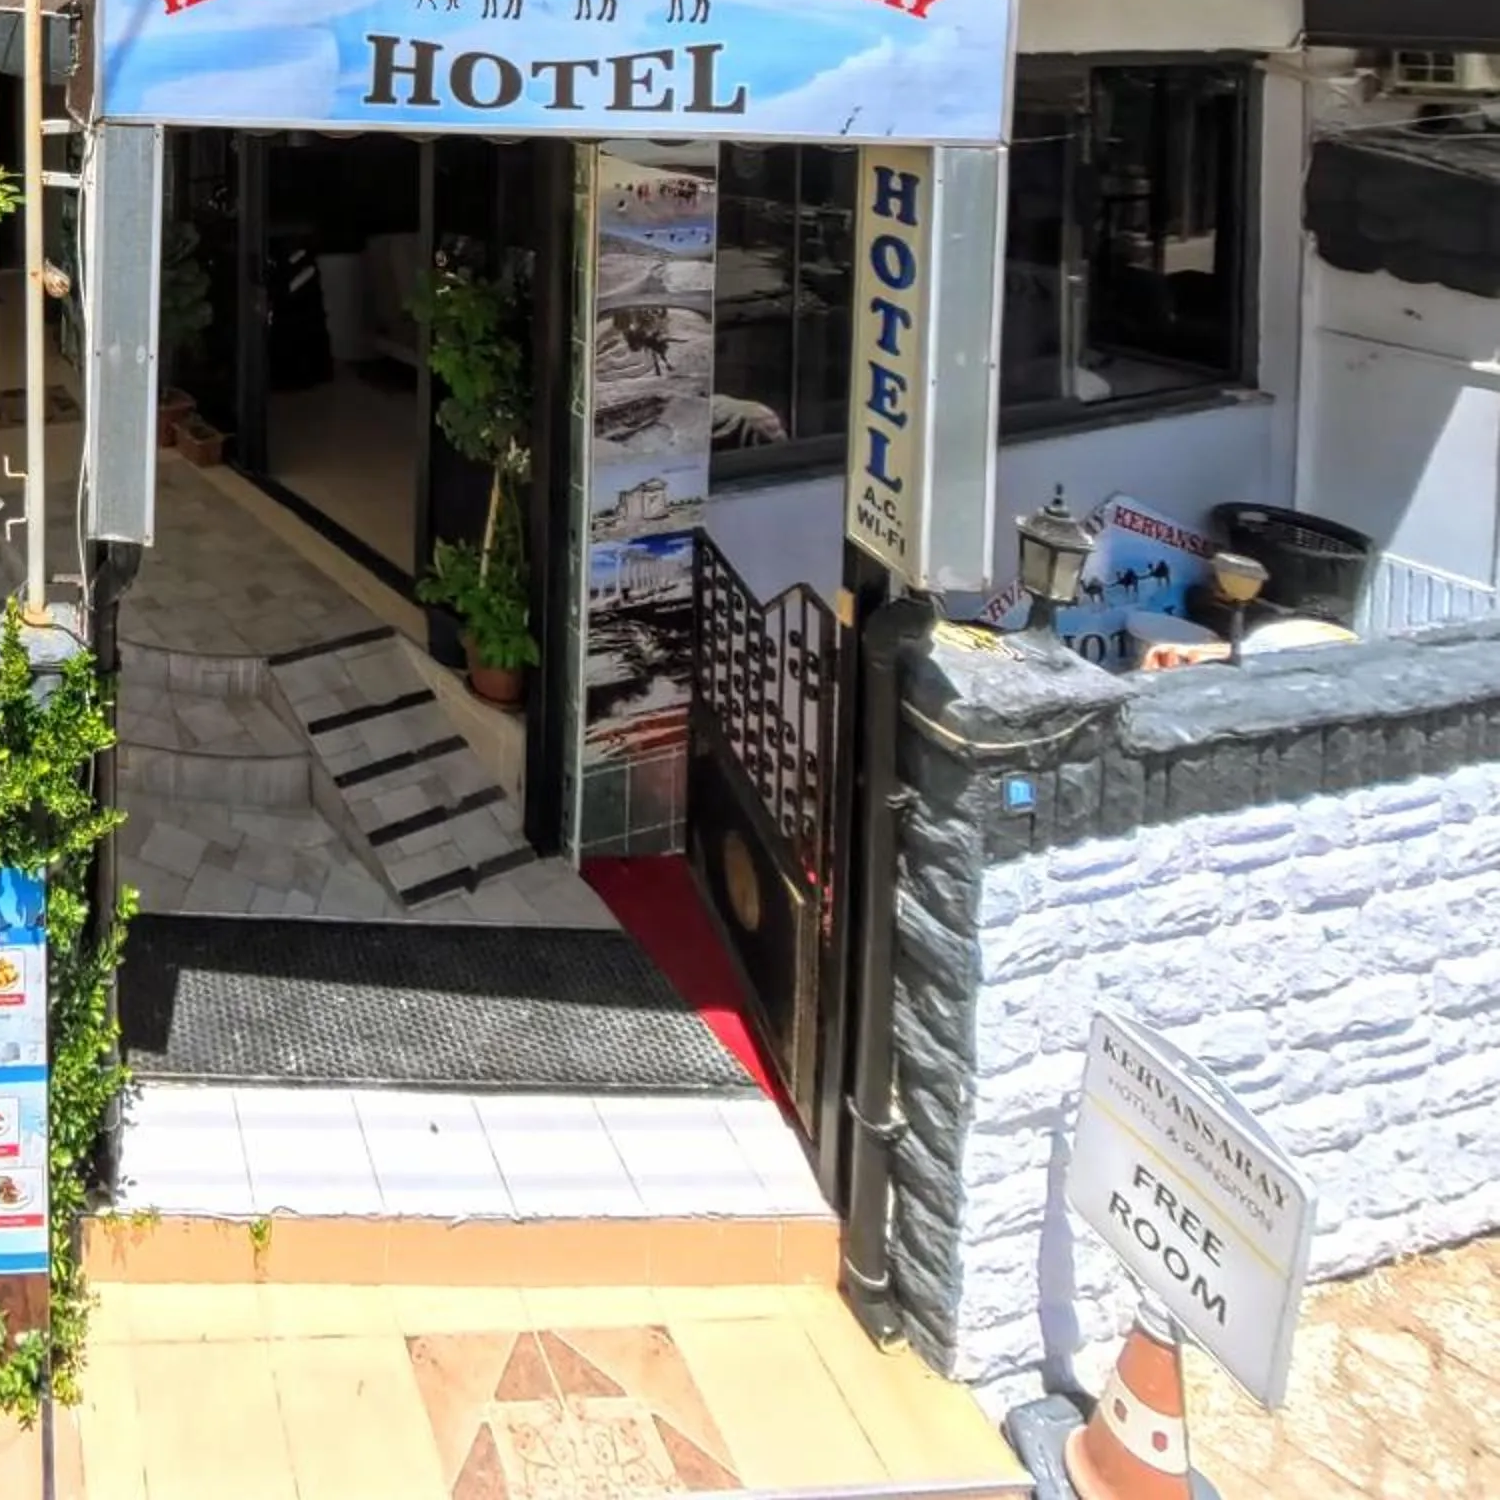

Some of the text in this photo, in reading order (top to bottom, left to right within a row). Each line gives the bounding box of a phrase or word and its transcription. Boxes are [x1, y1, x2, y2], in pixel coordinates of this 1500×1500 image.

[363, 34, 747, 115] HOTEL
[865, 165, 920, 494] HOTEL
[864, 485, 902, 528] A.C.
[1102, 1035, 1288, 1210] KERVANSARAY
[1109, 1190, 1228, 1326] ROOM
[1133, 1163, 1226, 1267] FREE
